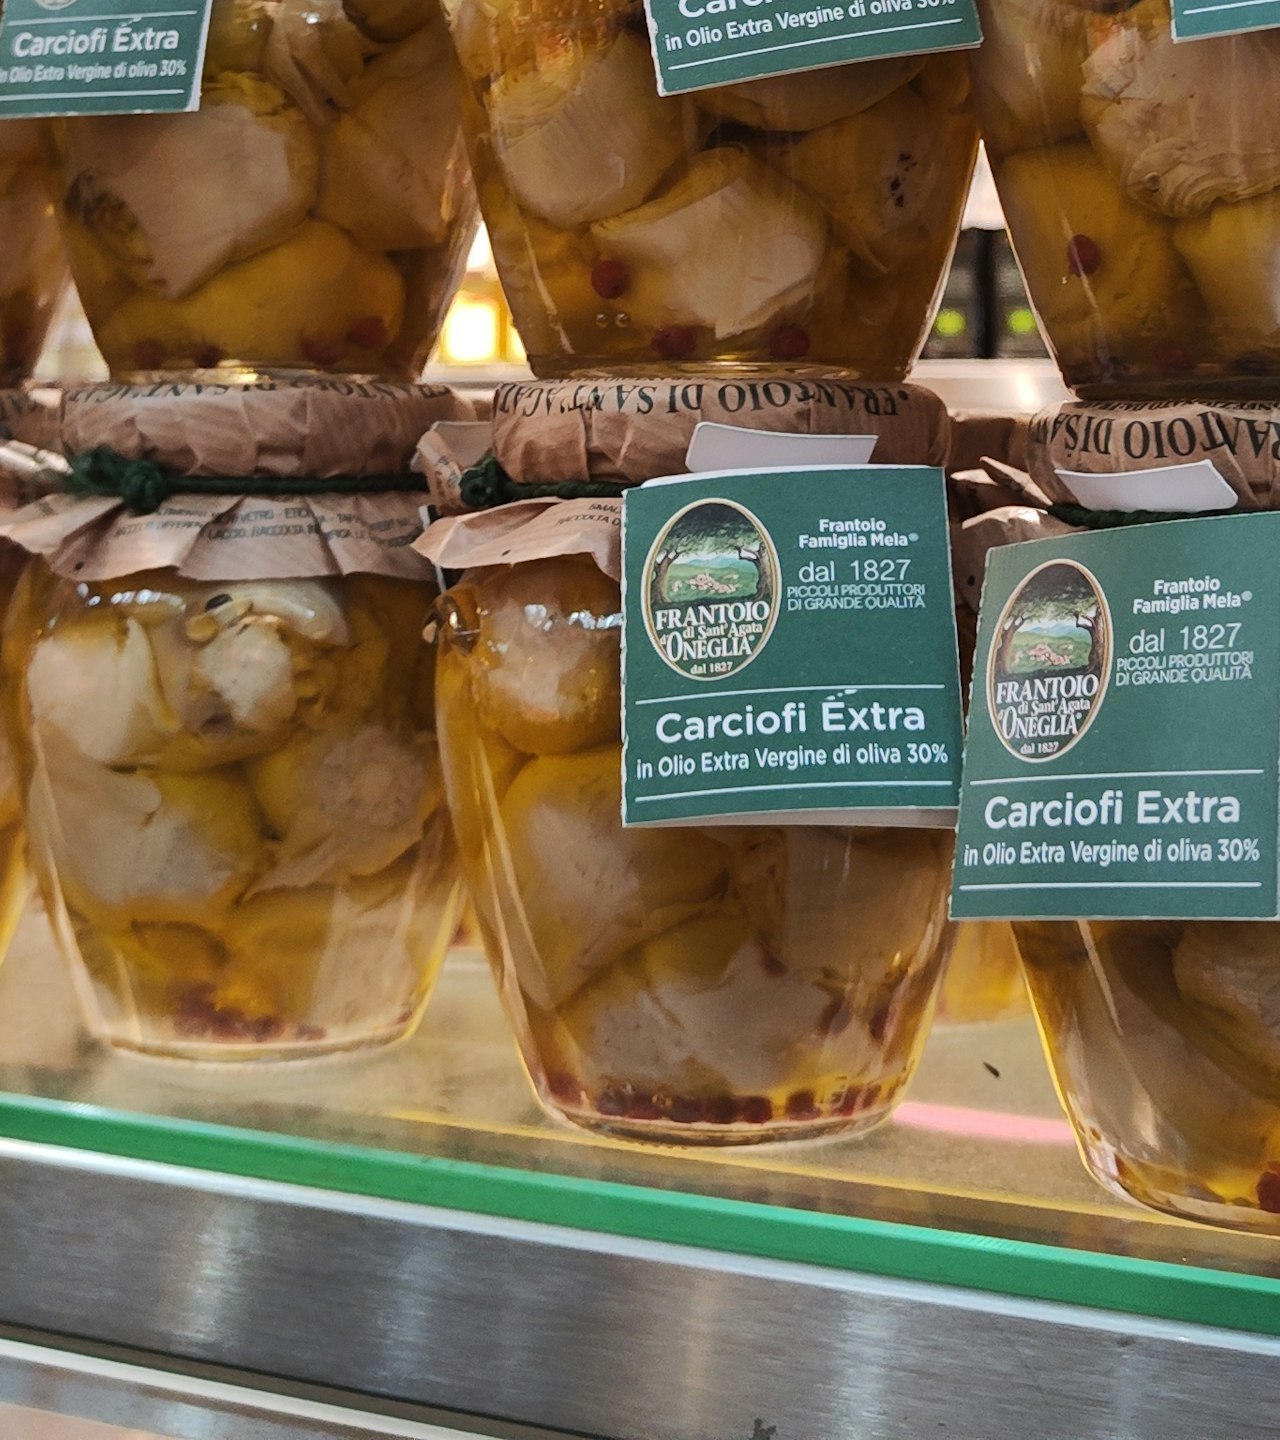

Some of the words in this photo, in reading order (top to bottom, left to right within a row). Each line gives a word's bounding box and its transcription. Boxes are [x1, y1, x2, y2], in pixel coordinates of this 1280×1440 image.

[664, 33, 682, 51] in
[685, 25, 722, 46] Olio
[725, 18, 773, 39] Extra
[774, 5, 844, 29] Vergine
[818, 517, 886, 532] Frantoio
[798, 532, 867, 549] Famiglia
[798, 560, 835, 583] dal
[849, 558, 911, 581] 1827
[786, 584, 839, 598] PICCOLI
[840, 583, 925, 596] PRODUTTORI
[1153, 575, 1220, 595] Frantoio
[787, 598, 802, 611] DI
[803, 594, 863, 610] GRANDE
[1132, 594, 1199, 614] Famiglia
[655, 600, 771, 630] FRANTOIO
[682, 625, 695, 639] di
[1128, 627, 1165, 654] dal
[1179, 622, 1242, 650] 1827
[1116, 655, 1166, 671] PICCOLI
[1168, 650, 1253, 668] PRODUTTORI
[1115, 668, 1133, 686] DI
[1131, 666, 1189, 685] GRANDE
[992, 673, 1099, 706] FRANTOIO
[1017, 700, 1028, 714] di
[655, 701, 806, 743] Carciofi
[821, 701, 925, 731] Extra
[636, 758, 652, 779] in
[657, 754, 695, 777] Olio
[700, 750, 749, 772] Extra
[754, 744, 827, 770] Vergine
[832, 743, 850, 764] di
[856, 742, 901, 764] oliva
[906, 742, 948, 763] 30%
[984, 789, 1123, 829] Carciofi
[1136, 789, 1240, 824] Extra
[963, 843, 978, 866] in
[982, 841, 1016, 865] Olio
[1019, 840, 1065, 864] Extra
[1069, 838, 1139, 863] Vergine
[1143, 838, 1162, 861] di
[1166, 837, 1212, 862] oliva
[1216, 837, 1260, 861] 30%
